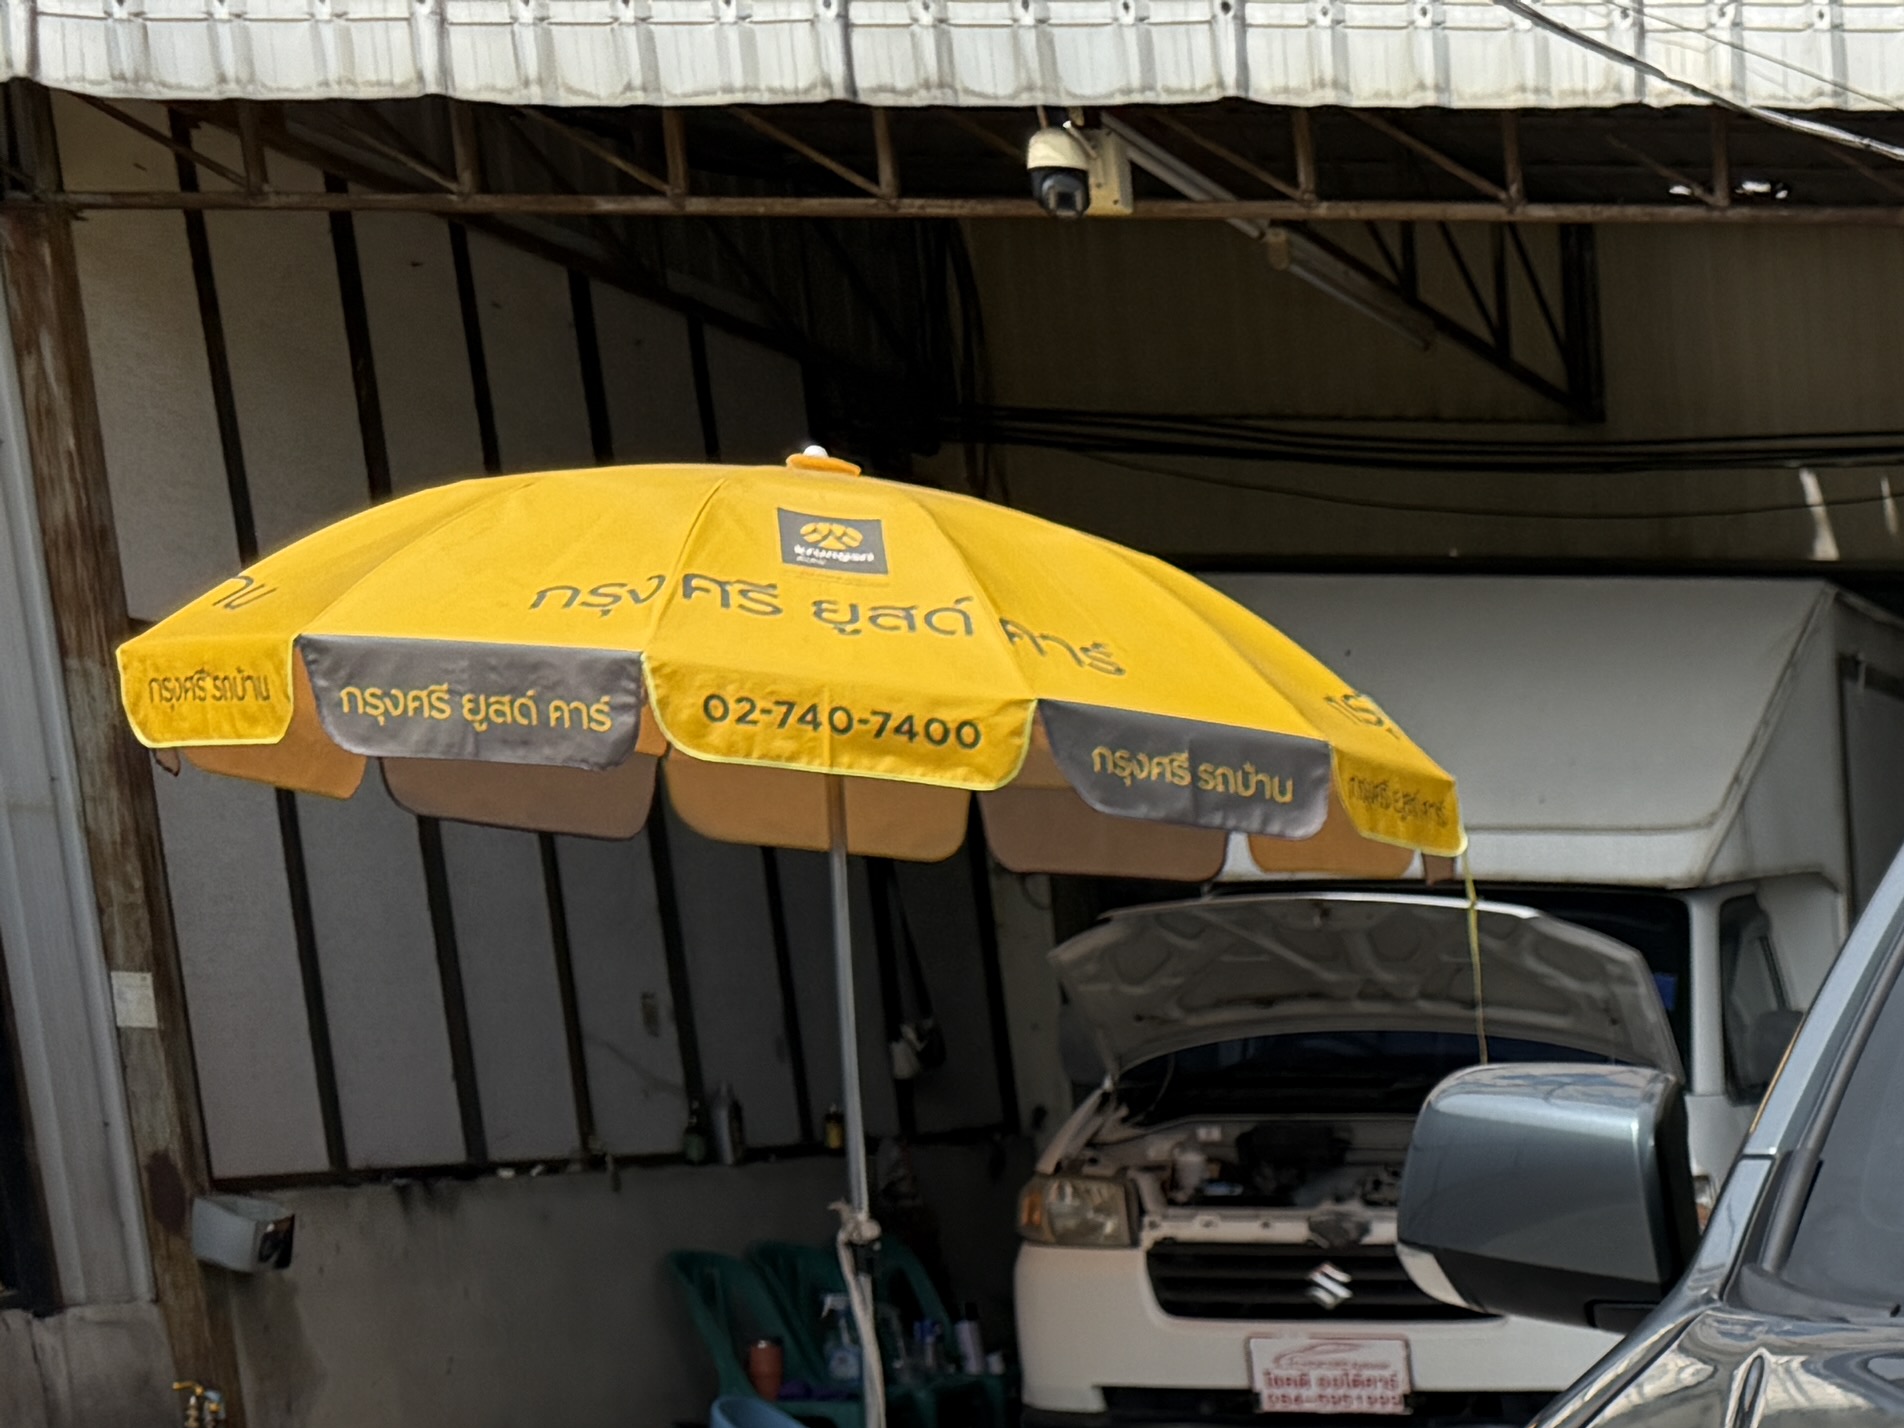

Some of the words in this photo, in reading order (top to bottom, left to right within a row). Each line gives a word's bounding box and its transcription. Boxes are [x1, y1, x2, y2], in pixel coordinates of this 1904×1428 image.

[529, 573, 784, 617] กรุงศรี
[811, 595, 975, 636] ยูสด์
[998, 616, 1127, 677] คาร์
[148, 666, 209, 713] กรุงศรี
[339, 682, 452, 726] กรุงศรี
[461, 688, 539, 733] ยูสด์
[548, 694, 614, 733] คาร์
[702, 692, 984, 751] 02-740-7400
[1091, 745, 1193, 788] กรุงศรี
[1197, 760, 1295, 805] รถบ้าน
